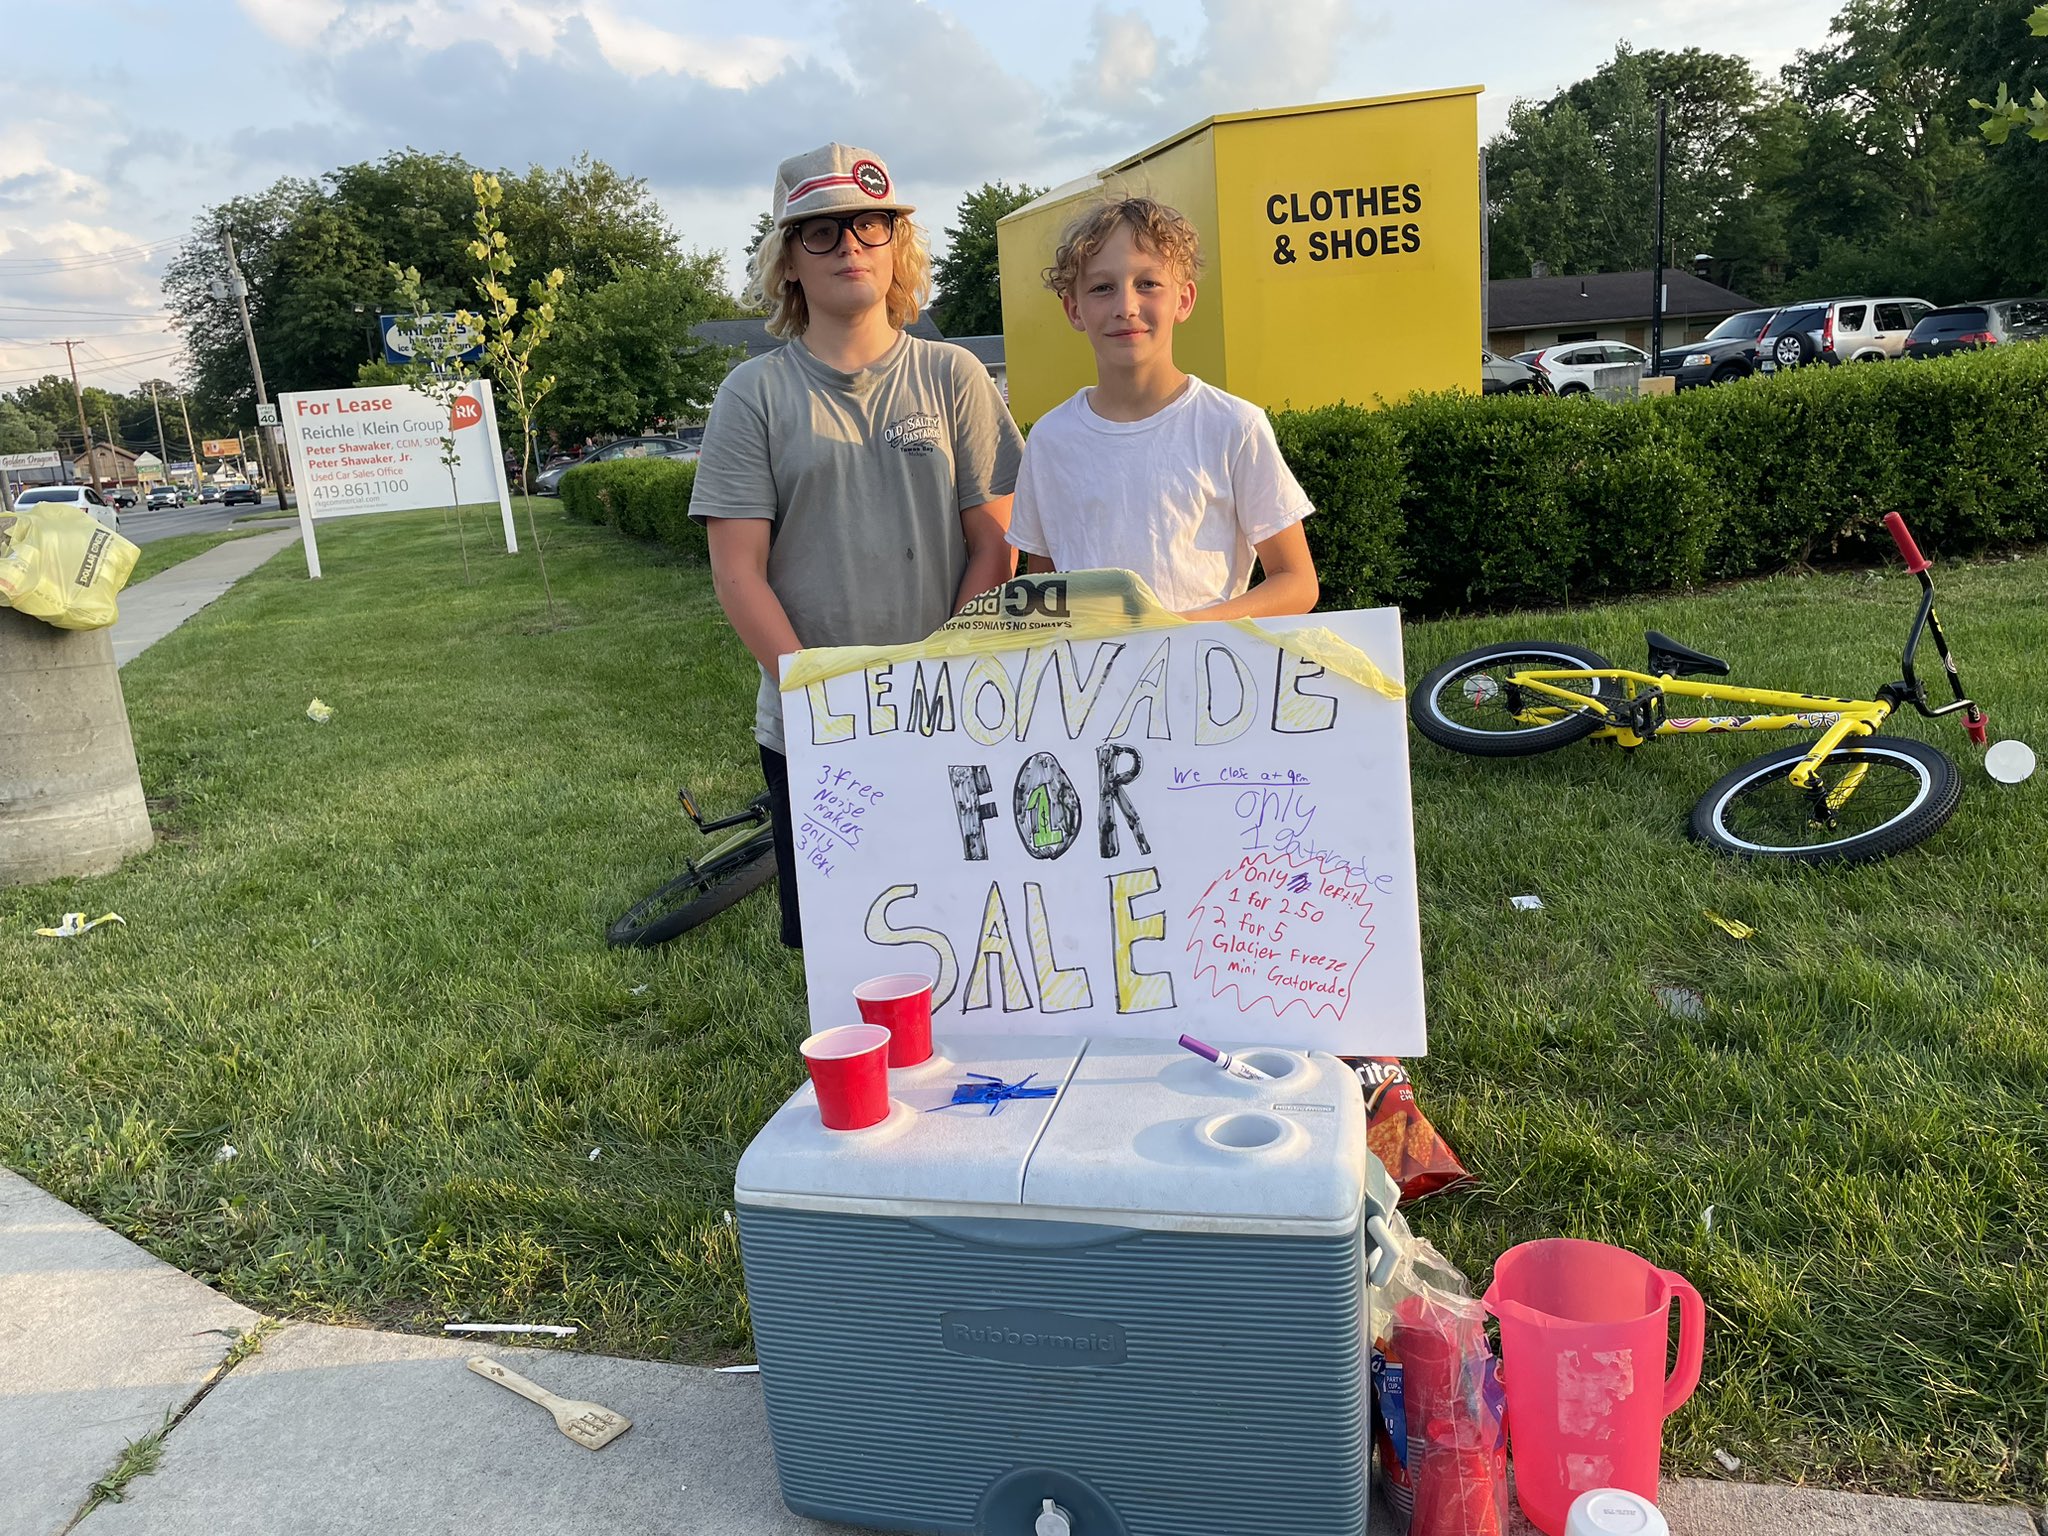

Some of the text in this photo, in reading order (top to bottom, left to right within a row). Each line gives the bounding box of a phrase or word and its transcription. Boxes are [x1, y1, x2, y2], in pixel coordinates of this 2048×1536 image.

[1266, 183, 1422, 225] CLOTHES
[1273, 223, 1421, 265] & SHOES
[297, 397, 393, 416] For Lease
[456, 404, 478, 418] RK
[260, 415, 276, 423] 40
[302, 419, 444, 440] Reichle Klein Group
[884, 417, 940, 442] OLD SALTY
[306, 445, 335, 455] Peter
[338, 440, 394, 453] Shawaker,
[2, 454, 53, 467] Golden Dragon
[308, 452, 413, 469] Peter Shawaker, Jr.
[311, 466, 403, 482] Used Car Sales Office
[313, 479, 409, 499] 419.861.1100
[79, 553, 98, 583] DOLLAR
[1005, 579, 1070, 618] DG
[957, 621, 971, 631] ON
[973, 621, 1012, 631] SAVINGS
[1012, 621, 1028, 630] ON
[1029, 621, 1072, 629] SAVINGS
[806, 637, 1337, 746] LEMONADE
[817, 765, 831, 784] 3
[1174, 767, 1201, 784] We
[1260, 772, 1282, 781] at
[813, 788, 865, 818] Noise
[947, 743, 1151, 861] FOR
[796, 835, 808, 851] 3
[1228, 888, 1324, 922] 1 for 2.50
[1213, 906, 1288, 942] 2 for 5
[864, 867, 1177, 1014] SALE
[1212, 934, 1347, 972] Glacier Freeze
[1267, 965, 1347, 998] Gatorade
[951, 1323, 1117, 1351] Rubbermaid
